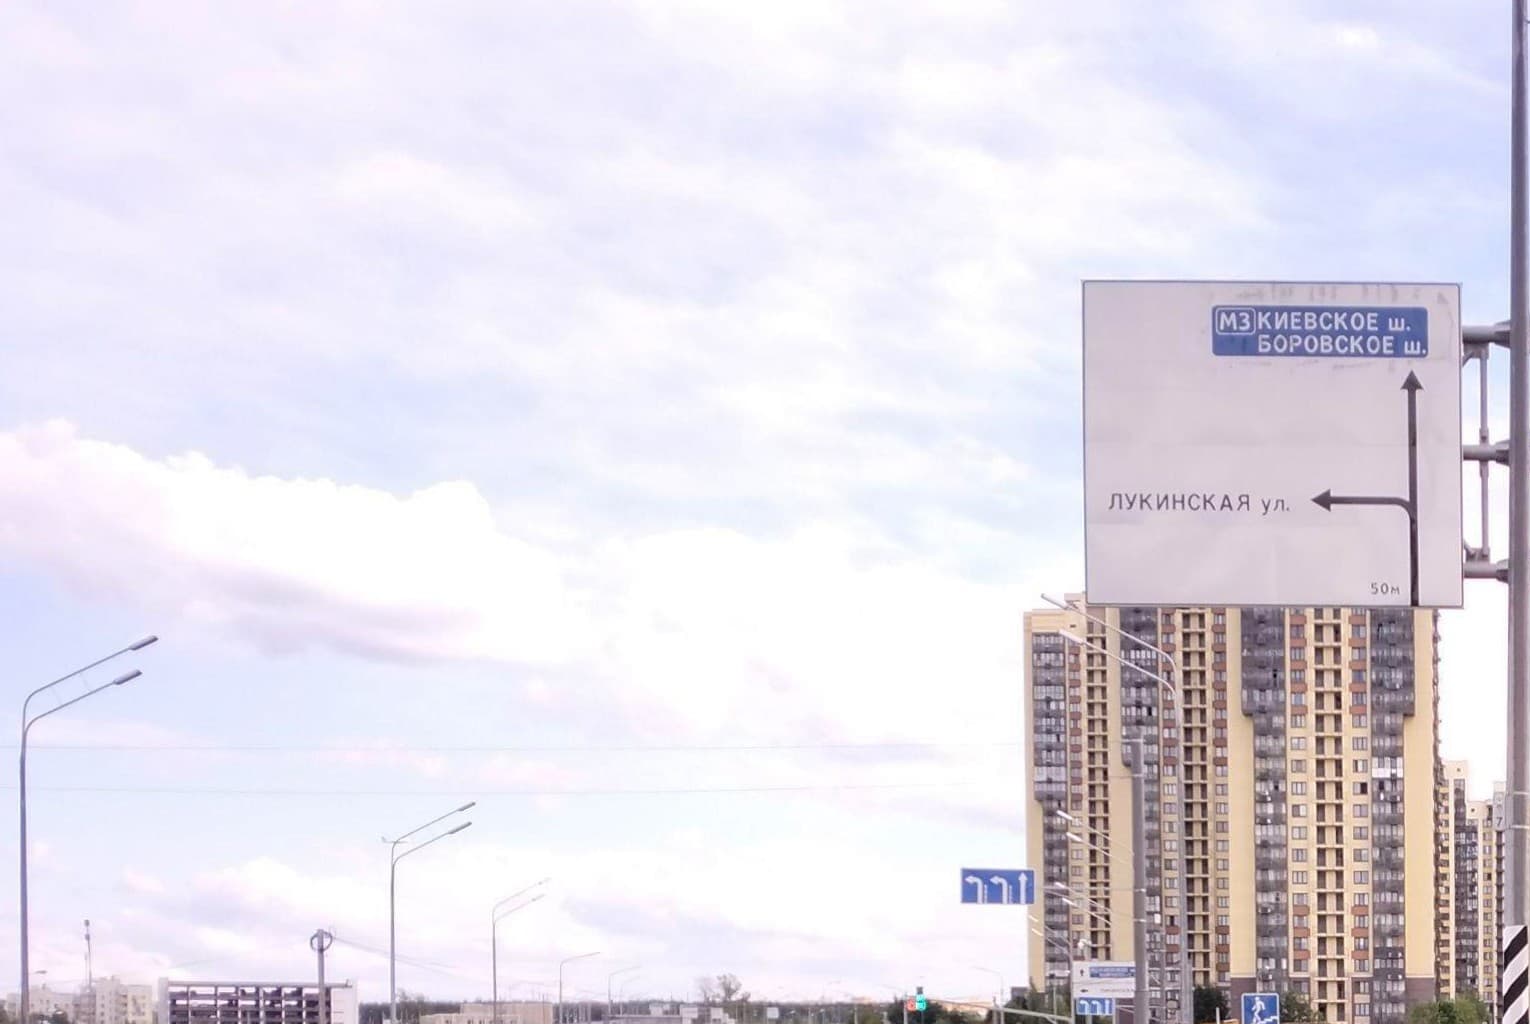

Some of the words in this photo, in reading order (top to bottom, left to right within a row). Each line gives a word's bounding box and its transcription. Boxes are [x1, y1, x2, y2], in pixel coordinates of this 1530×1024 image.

[1219, 311, 1251, 331] М3
[1258, 312, 1379, 332] КИЕВСКОЕ
[1388, 318, 1412, 332] ш.
[1258, 335, 1395, 354] БОРОВСКОЕ
[1403, 342, 1427, 355] ш.
[1108, 493, 1251, 512] ЛУКИНСКАЯ
[1261, 498, 1290, 516] ул.
